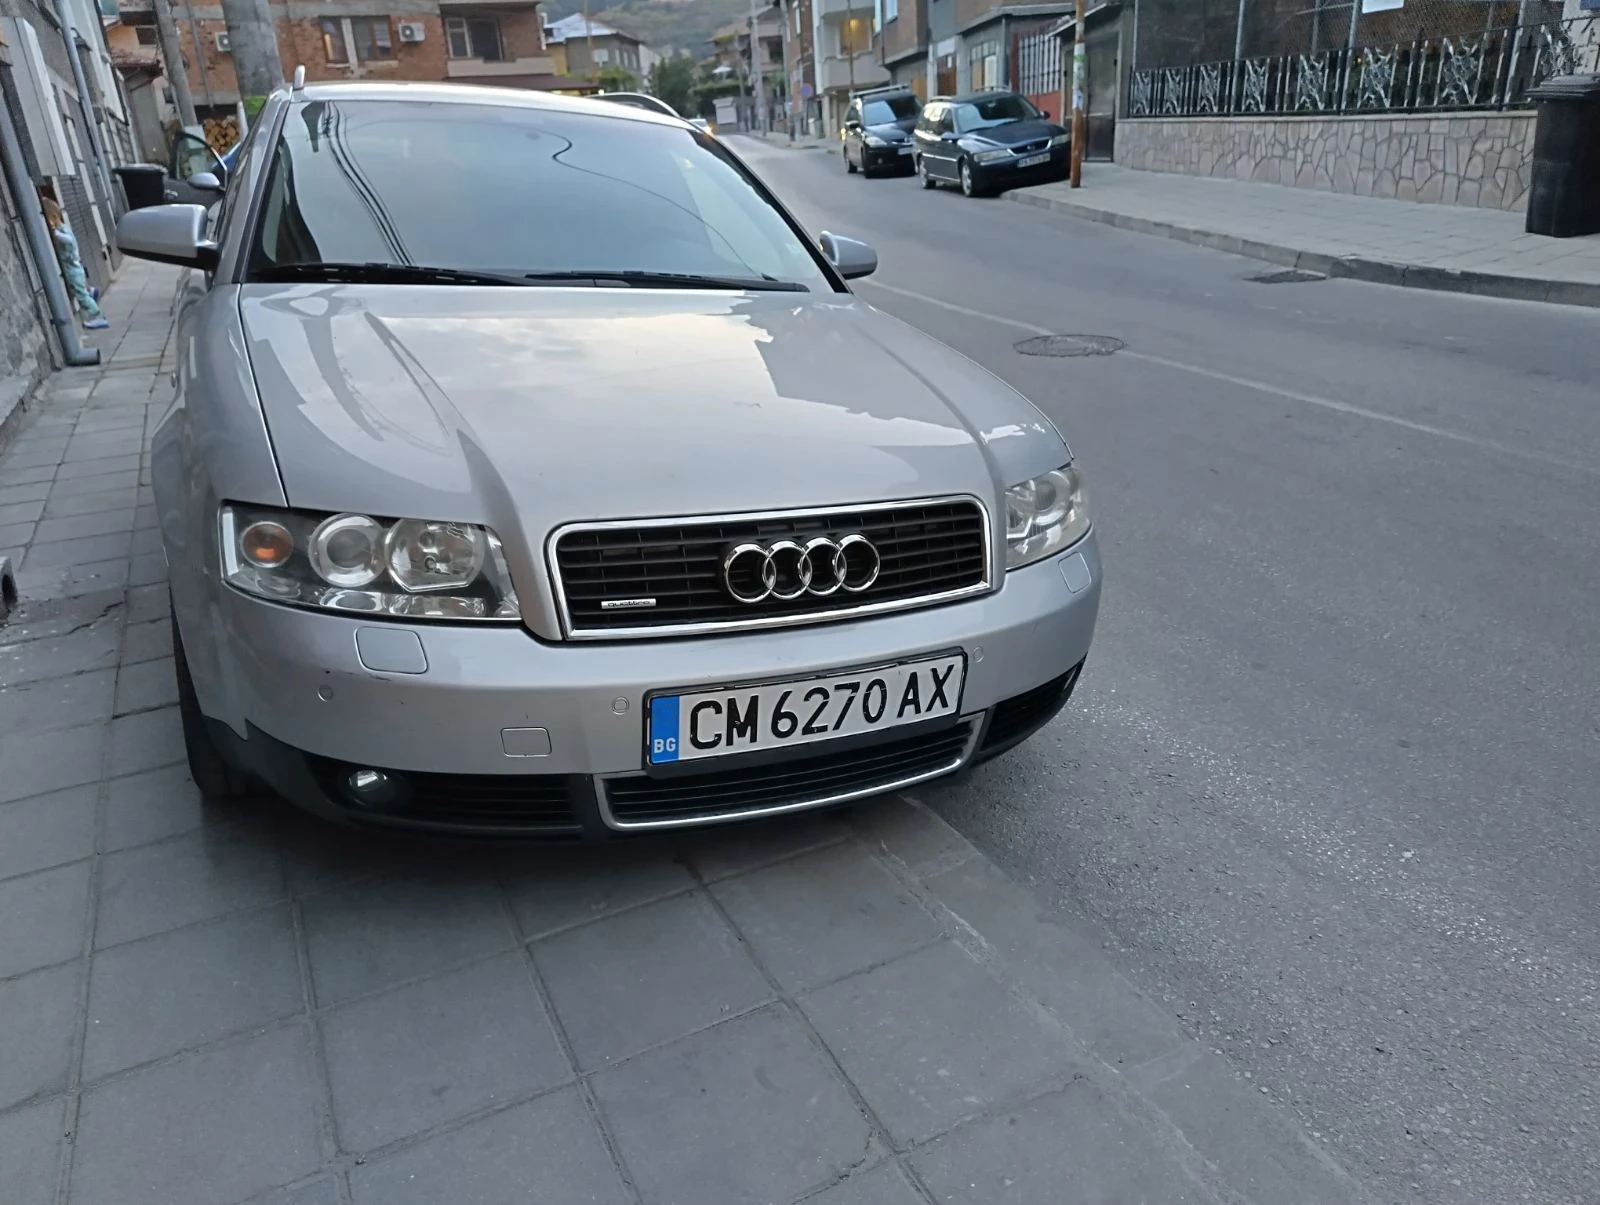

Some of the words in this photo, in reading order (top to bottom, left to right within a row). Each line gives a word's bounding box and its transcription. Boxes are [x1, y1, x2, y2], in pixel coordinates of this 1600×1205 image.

[689, 694, 759, 750] CM
[771, 678, 888, 739] 6270
[896, 664, 955, 718] AX
[653, 737, 676, 754] BG
